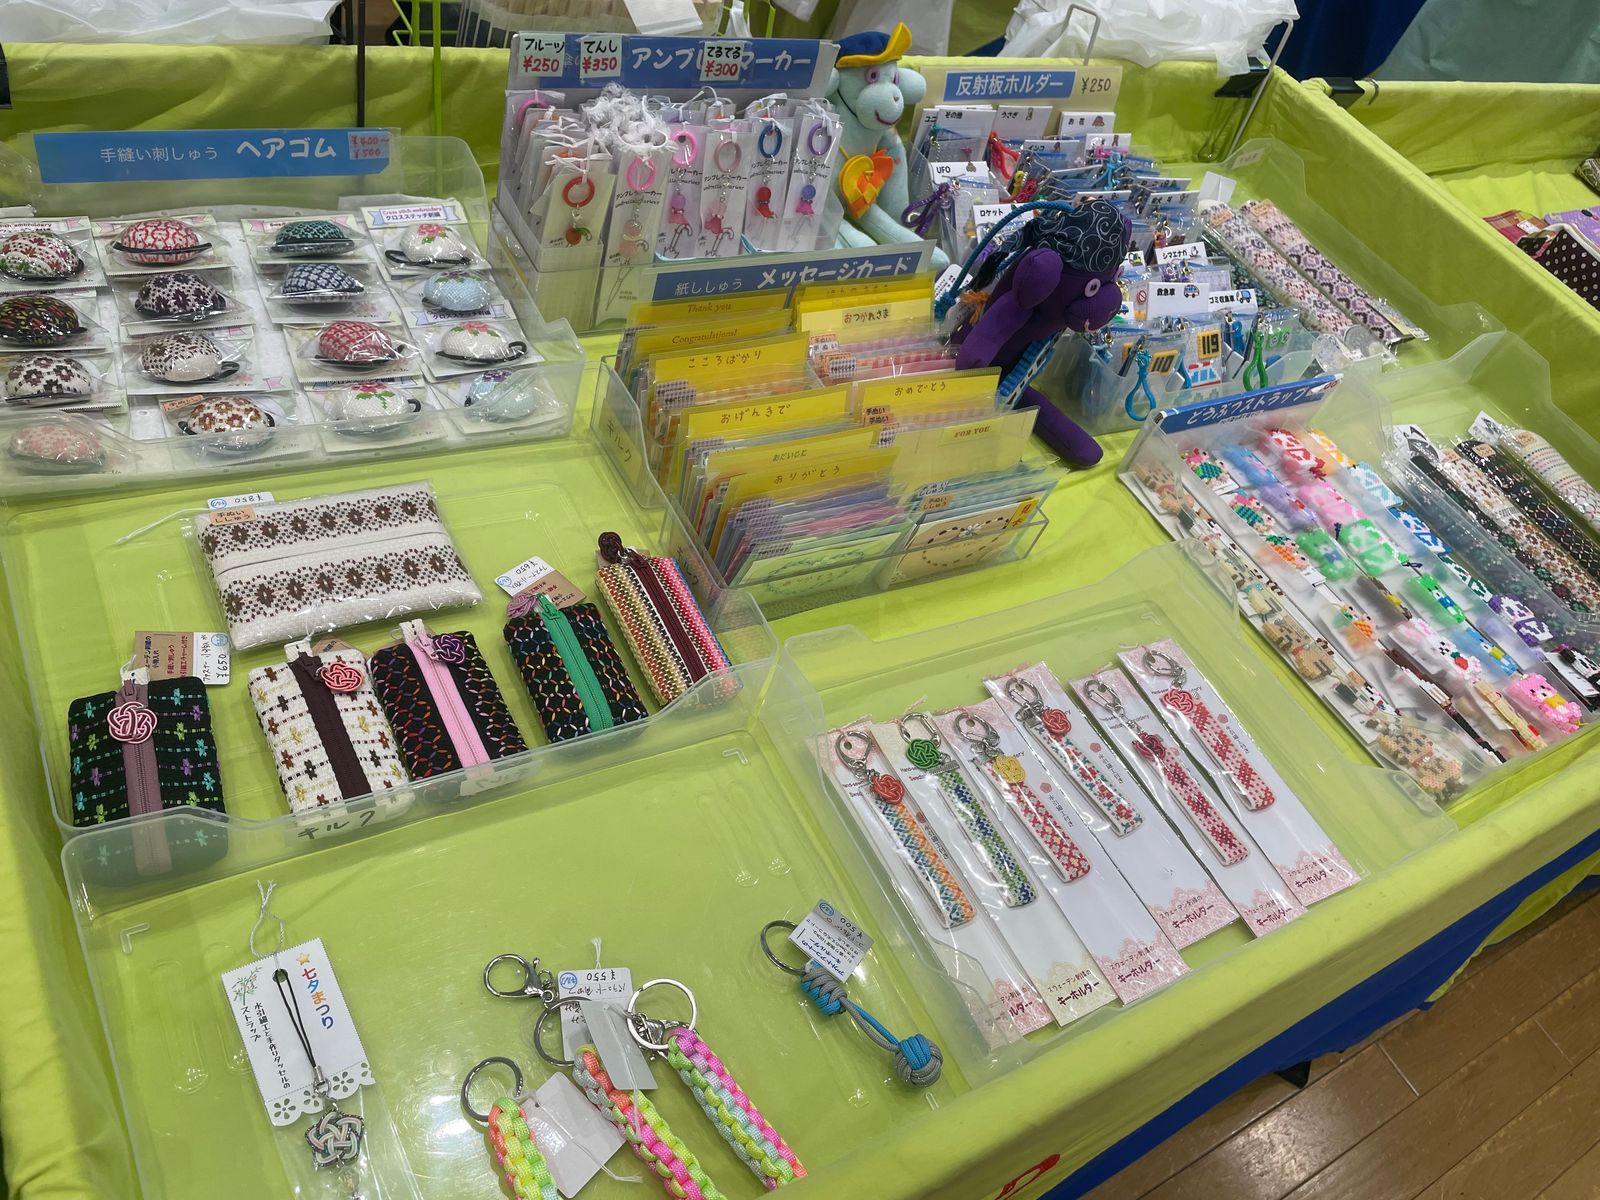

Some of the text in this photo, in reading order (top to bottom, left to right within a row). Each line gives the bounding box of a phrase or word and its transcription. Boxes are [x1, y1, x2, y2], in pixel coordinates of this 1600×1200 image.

[524, 38, 565, 53] フルーツ
[584, 39, 618, 54] てんし
[706, 46, 741, 60] てるてる
[522, 55, 560, 73] ¥250
[582, 55, 618, 74] ¥350
[632, 47, 811, 72] アンブマーカー
[704, 60, 738, 77] ¥300
[955, 70, 1112, 97] 反射板ホルダー ¥250
[100, 135, 337, 163] 手縫い刺しゅう ヘアゴム
[936, 165, 951, 174] UFO
[979, 208, 1003, 217] ロケット
[674, 278, 742, 297] 紙ししゅう
[757, 256, 912, 289] メッセージカード
[687, 302, 732, 313] Thank you
[844, 309, 889, 323] おつかれさま
[672, 328, 738, 344] Congratulations!
[1201, 332, 1219, 355] 119
[688, 350, 761, 368] こころばかり
[1151, 353, 1176, 373] 110
[895, 381, 947, 397] おめでとう
[720, 403, 791, 424] おげんきで
[1186, 387, 1310, 426] どうぶつストラップ
[954, 425, 990, 438] FOR YOU
[773, 465, 840, 484] ありがとう
[217, 510, 245, 518] 手ぬい
[515, 560, 538, 575] ¥650
[216, 653, 228, 678] ¥650
[297, 810, 376, 840] キルク
[1295, 868, 1334, 889] キーホルダー
[1172, 904, 1214, 929] キーホルダー
[1256, 907, 1293, 926] キーホルダー
[839, 917, 863, 939] ¥500
[586, 969, 616, 982] ¥550
[1117, 958, 1161, 983] キーホルダー
[301, 967, 334, 1030] 七夕まつり
[1057, 981, 1101, 1006] キーホルダー
[241, 1005, 261, 1042] ストラップ
